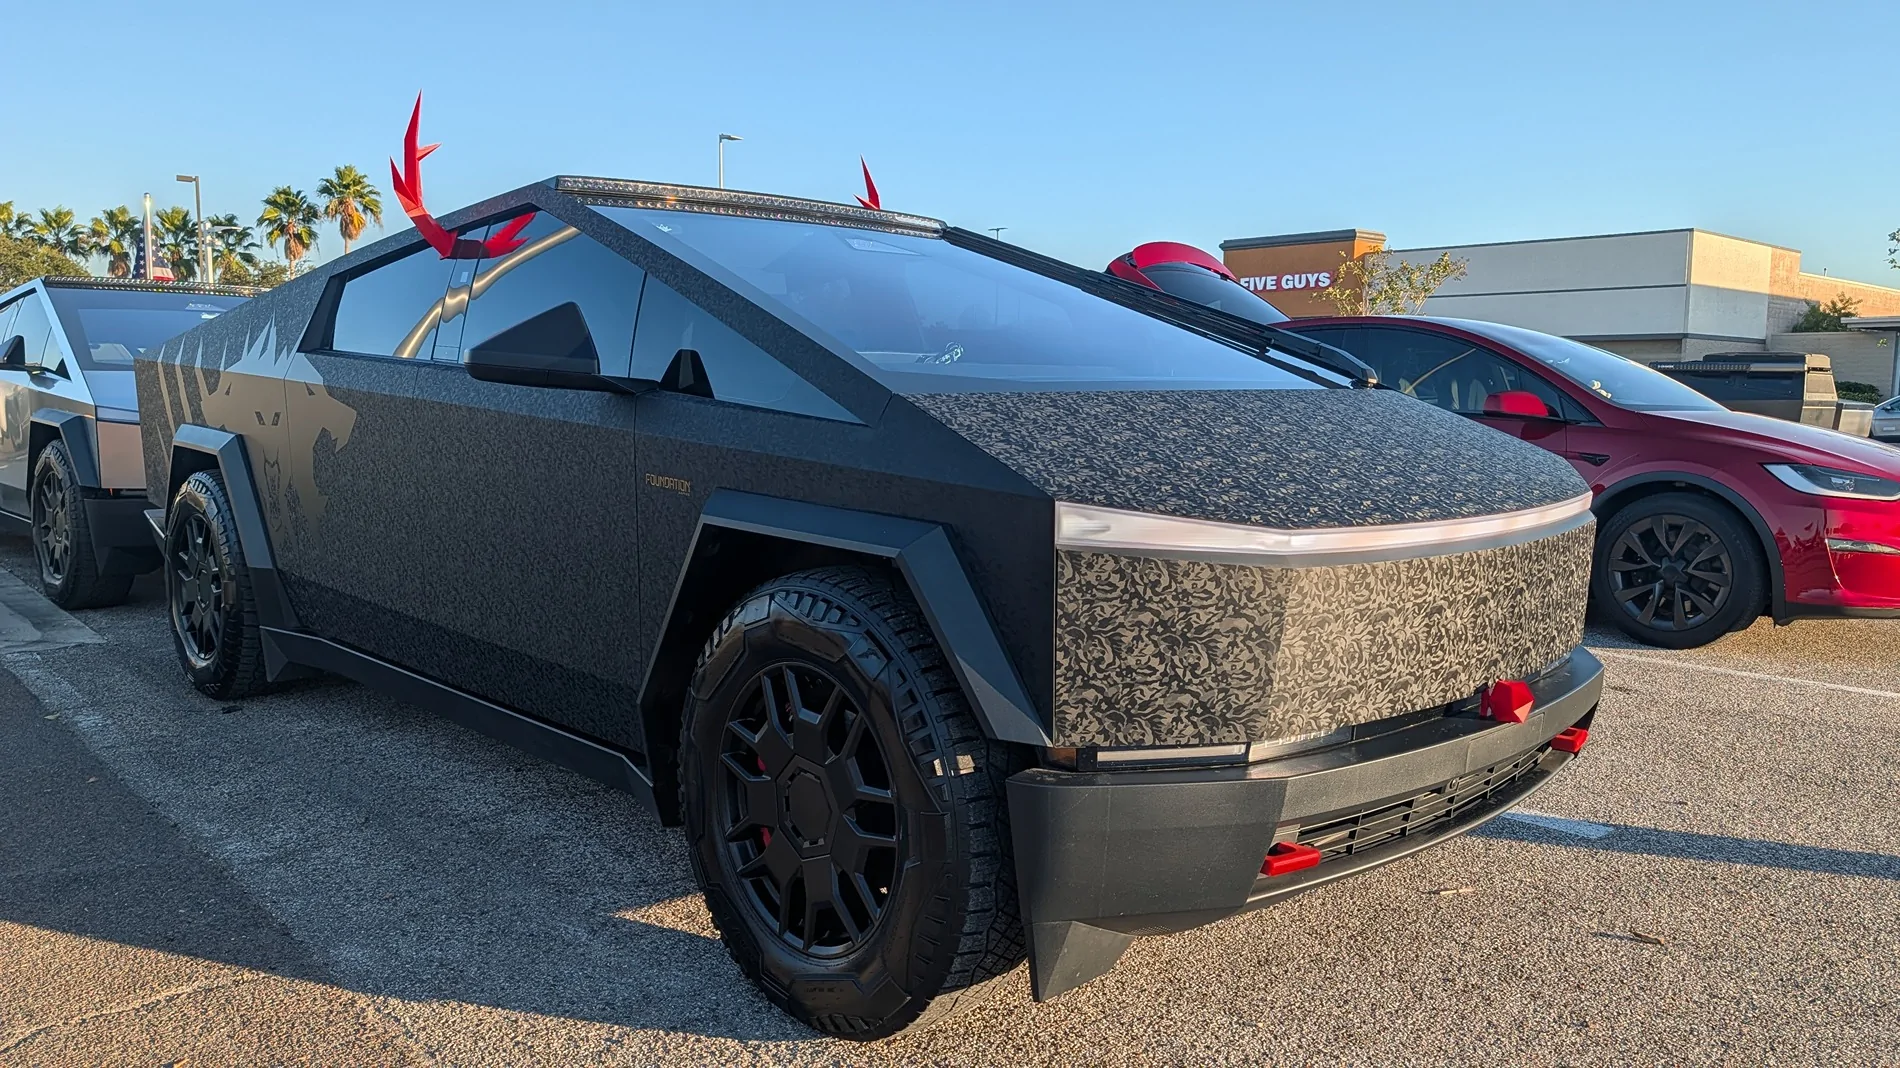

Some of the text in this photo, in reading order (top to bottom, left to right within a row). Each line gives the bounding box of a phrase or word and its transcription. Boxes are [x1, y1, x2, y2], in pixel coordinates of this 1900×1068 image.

[1240, 272, 1331, 291] FIVE GUYS
[645, 473, 691, 493] FOUNDATION
